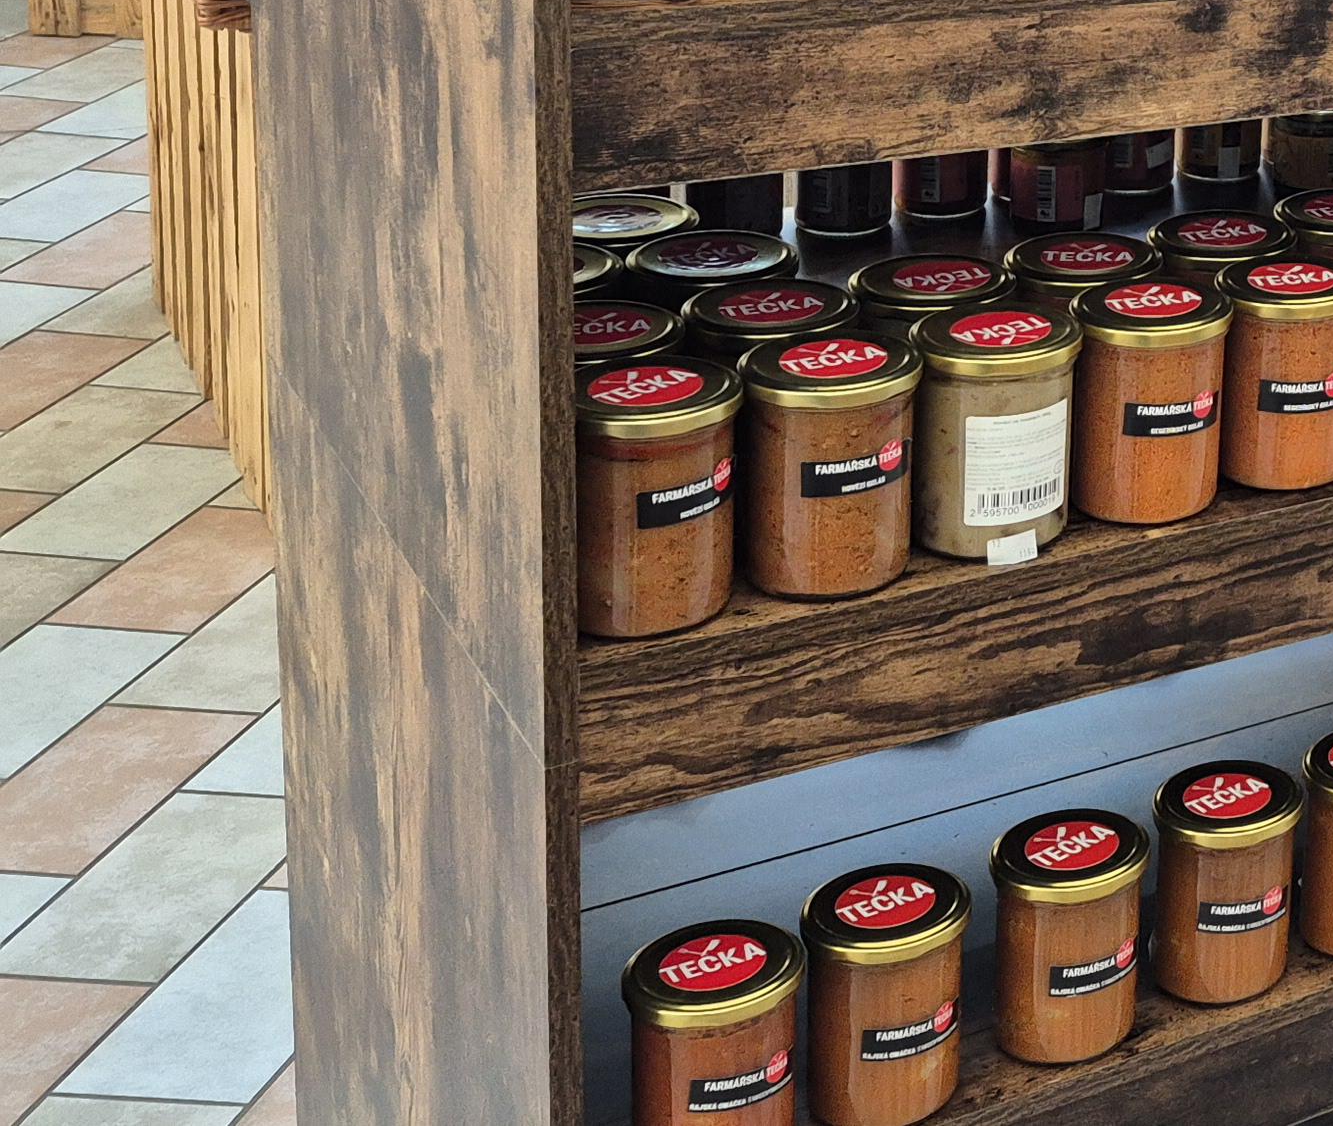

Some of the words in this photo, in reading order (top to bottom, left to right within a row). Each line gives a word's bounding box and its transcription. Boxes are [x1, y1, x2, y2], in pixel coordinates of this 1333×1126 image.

[1179, 221, 1267, 242] TEČKA
[1042, 247, 1135, 263] TEČKA
[895, 265, 989, 288] TEČKA
[720, 296, 825, 318] TEČKA
[1105, 290, 1202, 311] TEČKA
[573, 317, 651, 335] EČKA
[951, 316, 1052, 343] TEČKA
[783, 344, 888, 371] TEČKA
[591, 368, 699, 404] TEČKA
[1271, 380, 1324, 395] FARMÁŘSKÁ
[1137, 402, 1192, 416] FARMÁŘSKÁ
[815, 456, 878, 476] FARMÁŘSKÁ
[651, 476, 714, 505] FARMÁŘSKÁ
[969, 508, 976, 518] 2
[983, 506, 1020, 518] 595700
[1183, 776, 1272, 816] TEČKA
[1028, 824, 1116, 868] TEČKA
[836, 880, 935, 924] TEČKA
[1210, 902, 1262, 916] FARMÁŘSKÁ
[658, 940, 767, 983] TEČKA
[1063, 956, 1116, 979] FARMÁŘSKÁ
[876, 1018, 933, 1042] FARMÁŘSKÁ
[703, 1068, 766, 1092] FARMÁŘSKÁ
